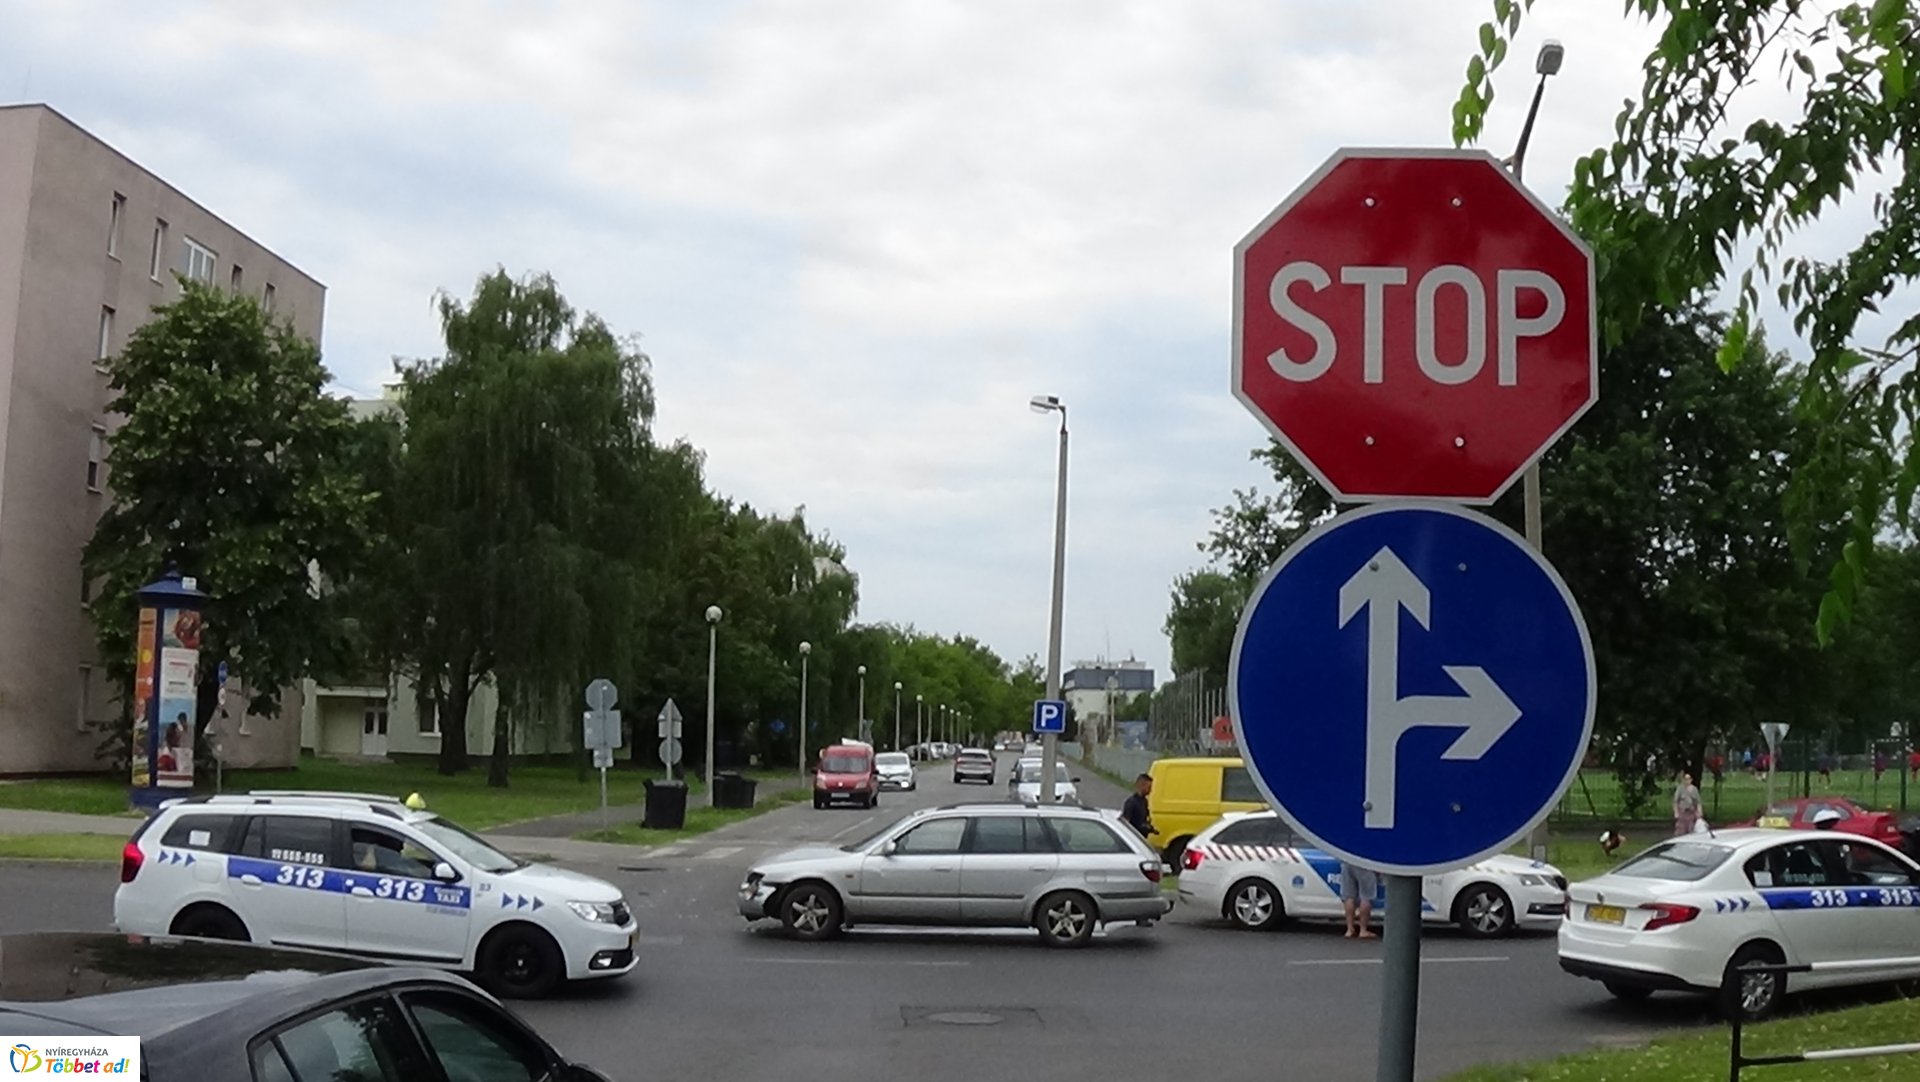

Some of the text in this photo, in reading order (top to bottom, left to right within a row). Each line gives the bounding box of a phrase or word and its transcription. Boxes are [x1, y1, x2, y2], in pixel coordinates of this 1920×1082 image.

[1266, 261, 1566, 386] STOP
[1041, 704, 1059, 728] P
[276, 865, 425, 902] 313 313
[1811, 890, 1848, 907] 313
[1879, 889, 1913, 906] 313
